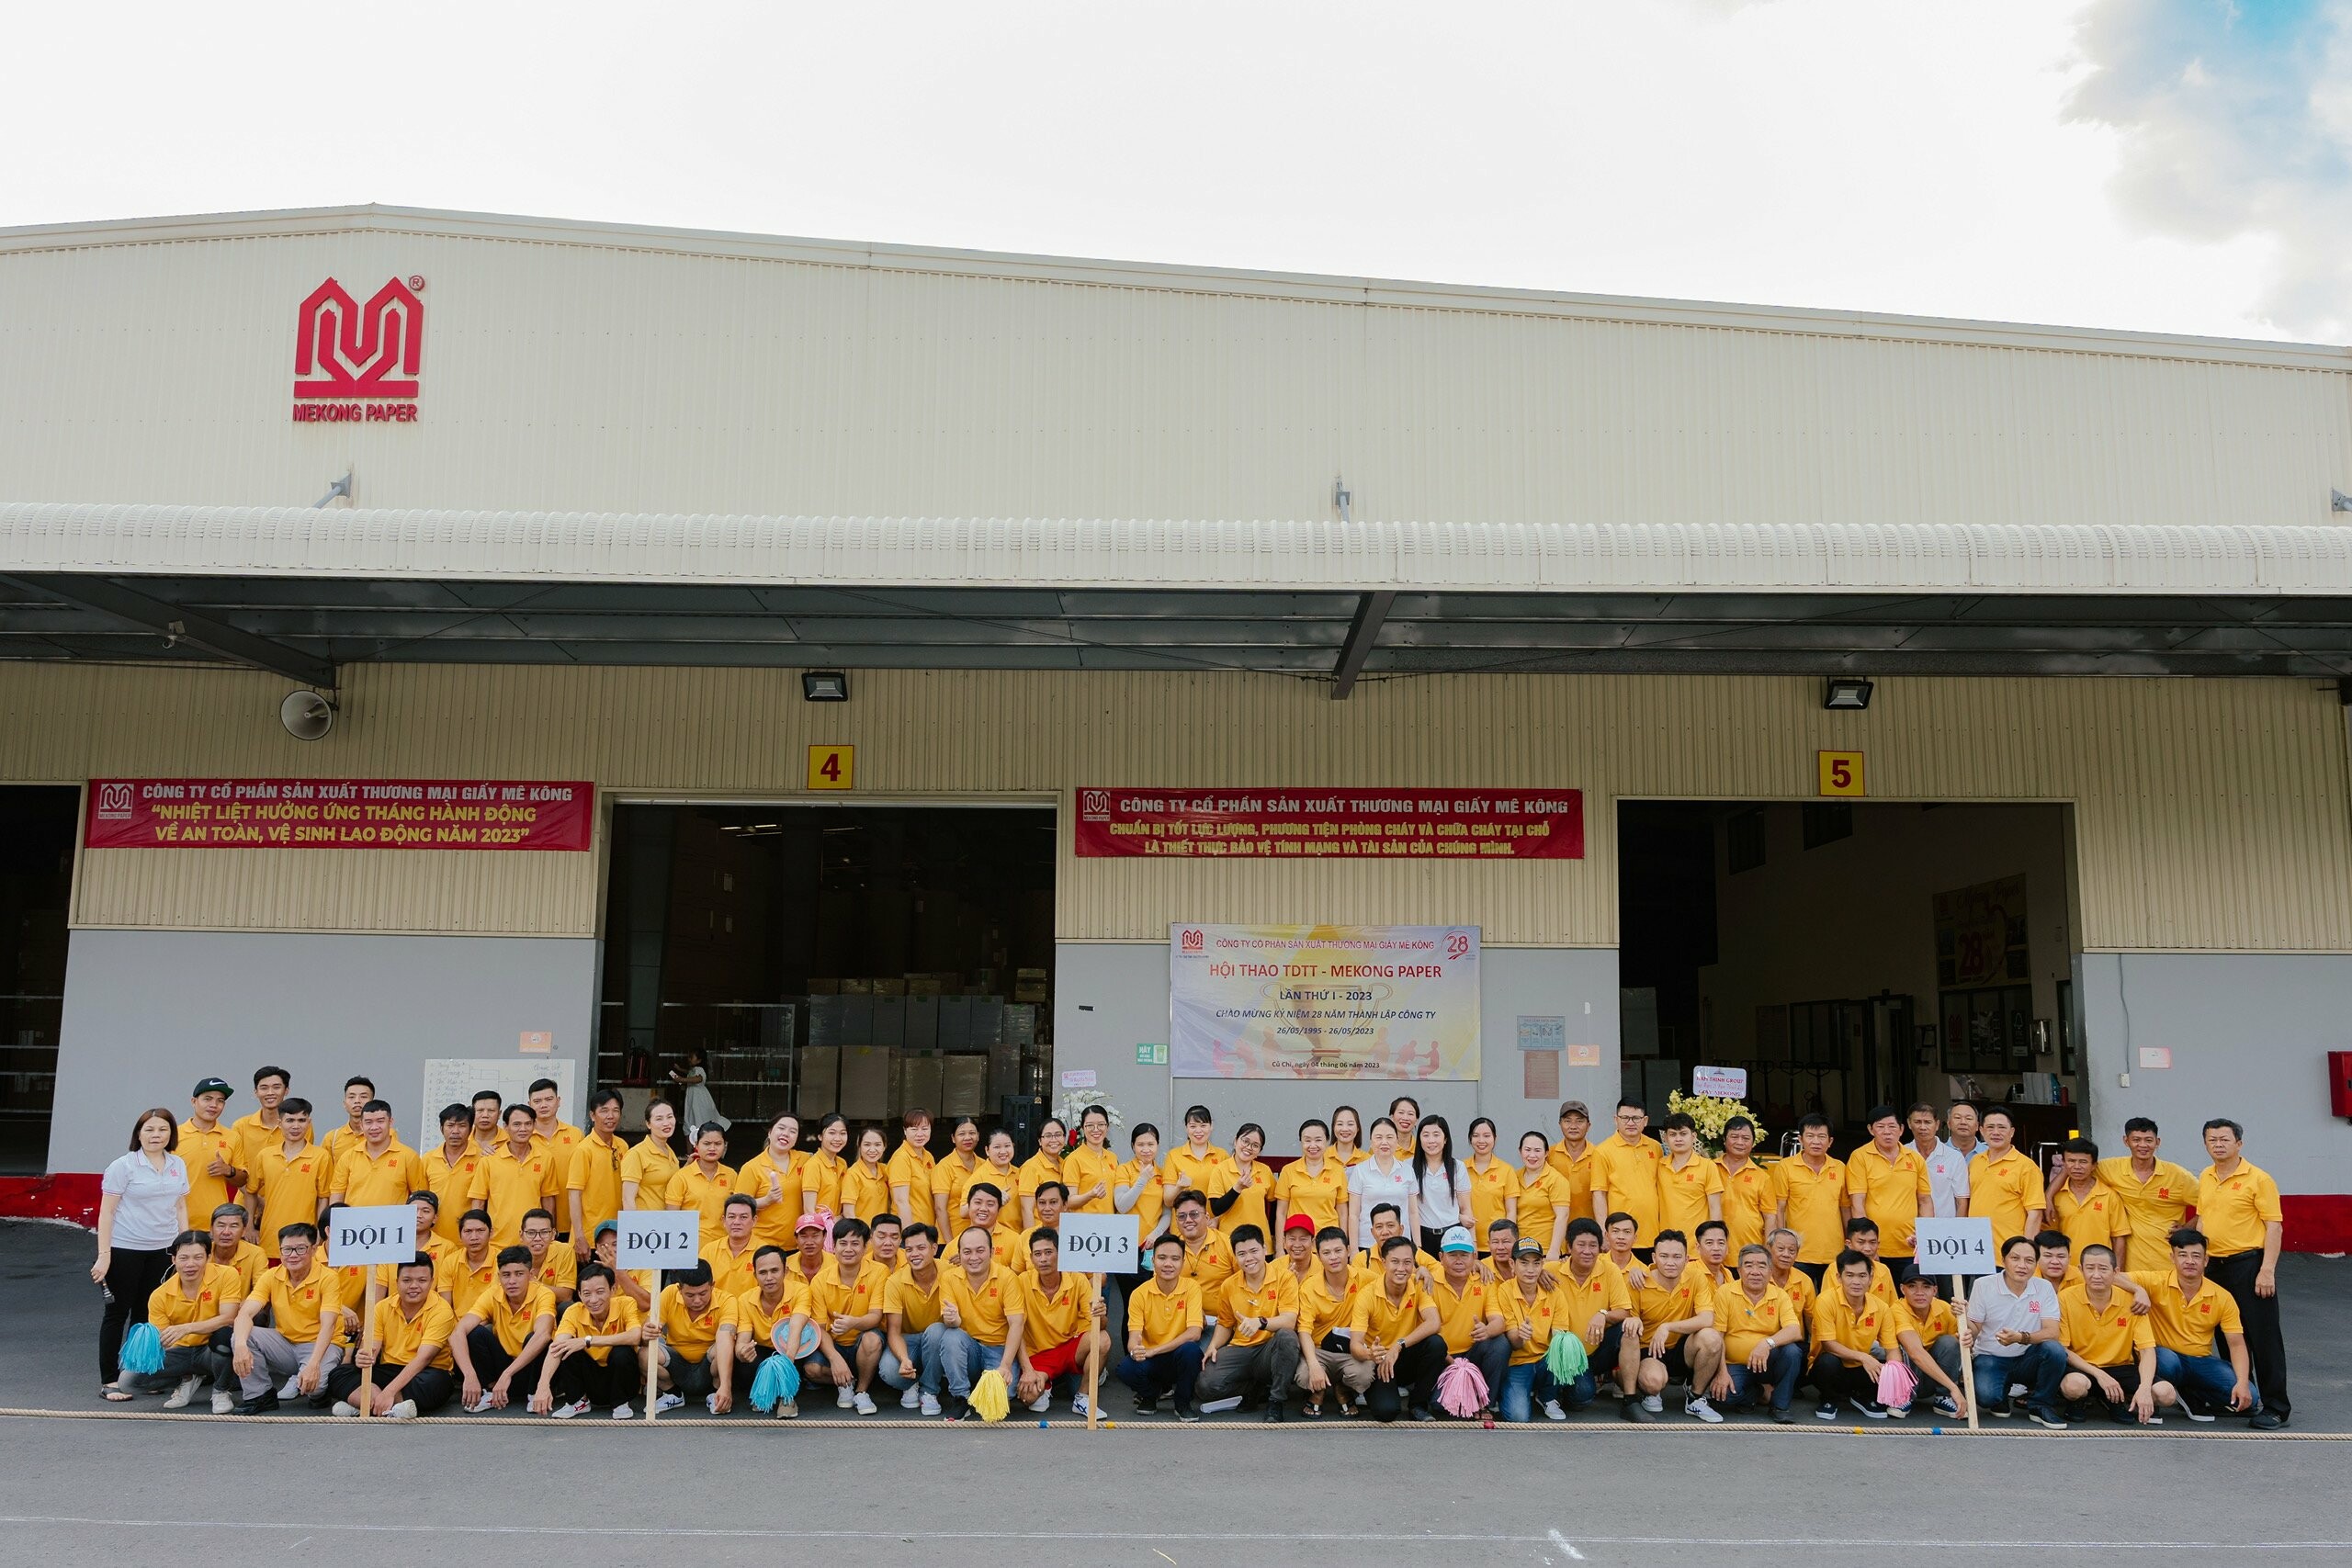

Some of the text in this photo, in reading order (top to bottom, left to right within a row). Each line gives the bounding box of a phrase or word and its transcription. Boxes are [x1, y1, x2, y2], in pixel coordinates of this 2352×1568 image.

[292, 403, 418, 423] MEKONG PAPER
[820, 753, 842, 782] 4
[1832, 760, 1851, 788] 5
[142, 781, 572, 802] CÔNG TY CỔ PHẦN SẢN XUẤT THƯƠNG MẠI GIẤY MÊ KÔNG
[215, 802, 252, 824] LIỆT
[255, 800, 319, 820] HƯỞNG
[323, 801, 360, 820] ỨNG
[365, 802, 424, 821] THÁNG
[429, 802, 480, 821] HÀNH
[484, 803, 537, 826] ĐỘNG
[1120, 795, 1568, 815] CÔNG TY CỔ PHẦN SẢN XUẤT THƯƠNG MẠI GIẤY MÊ KÔNG
[155, 821, 179, 840] VỀ
[181, 826, 207, 840] AN
[211, 821, 264, 843] TOÀN,
[268, 823, 290, 844] VỆ
[295, 826, 336, 841] SINH
[340, 827, 376, 841] LAO
[380, 824, 432, 846] ĐỘNG
[436, 824, 477, 842] NĂM
[1152, 824, 1165, 837] BỊ
[1168, 819, 1188, 835] TỐT
[1191, 823, 1214, 837] LỰC
[1216, 823, 1259, 837] LƯỢNG,
[1261, 823, 1308, 835] PHƯƠNG
[1312, 821, 1339, 838] TIỆN
[1341, 821, 1382, 836] PHÒNG
[1385, 822, 1416, 836] CHÁY
[1419, 822, 1434, 835] VÀ
[1436, 822, 1468, 836] CHỮA
[1471, 822, 1502, 836] CHÁY
[1505, 824, 1523, 838] TẠI
[1145, 840, 1159, 852] LÀ
[1162, 838, 1194, 852] THIẾT
[1197, 840, 1227, 856] THỰC
[1230, 840, 1254, 853] BẢO
[1256, 840, 1272, 856] VỆ
[1274, 840, 1301, 853] TÍNH
[1305, 841, 1340, 856] MẠNG
[1343, 840, 1358, 853] VÀ
[1361, 840, 1379, 853] TÀI
[1382, 839, 1407, 853] SẢN
[1409, 839, 1433, 853] CỦA
[1436, 840, 1476, 854] CHÚNG
[1240, 941, 1250, 949] TY
[1447, 935, 1469, 953] 28
[1209, 961, 1235, 978] HỘI
[1239, 964, 1279, 976] THAO
[1283, 964, 1317, 977] TDTT
[1330, 965, 1394, 977] MEKONG
[1398, 965, 1442, 978] PAPER
[1280, 987, 1301, 1000] LẦN
[1305, 989, 1329, 1000] THỨ
[1346, 991, 1373, 1000] 2023
[1216, 1008, 1240, 1018] CHÀO
[1311, 1010, 1322, 1019] 28
[1398, 1009, 1423, 1019] CÔNG
[1277, 1027, 1322, 1035] 26/05/1995
[1329, 1027, 1374, 1036] 26/05/2023
[340, 1224, 404, 1249] ĐỘI 1
[627, 1229, 688, 1254] ĐỘI 2
[1068, 1232, 1128, 1258] ĐỘI 3
[1927, 1235, 1984, 1259] ĐỘI 4
